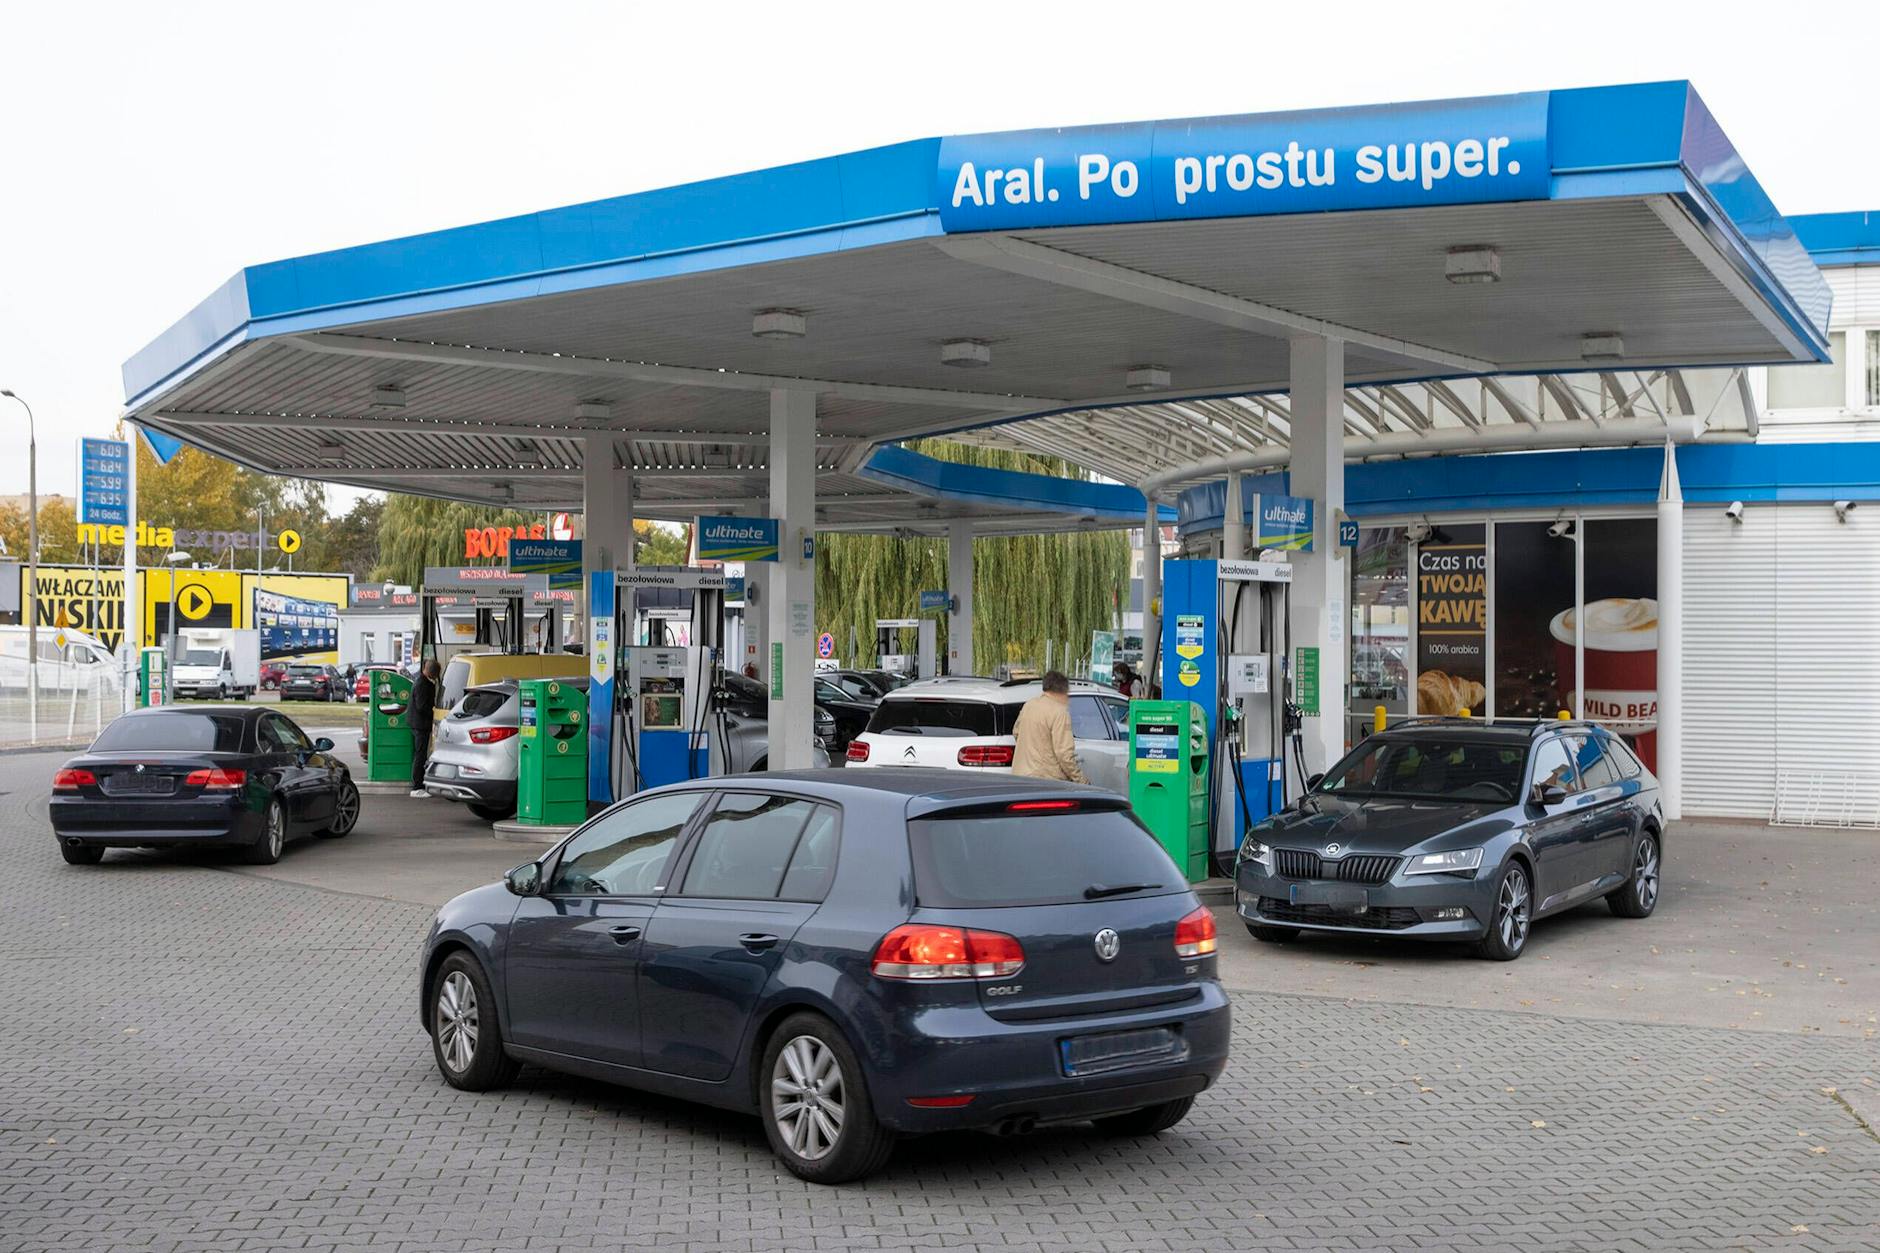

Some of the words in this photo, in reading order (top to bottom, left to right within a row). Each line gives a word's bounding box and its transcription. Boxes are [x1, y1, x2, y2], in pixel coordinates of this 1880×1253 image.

[952, 157, 1059, 207] Aral.
[1079, 153, 1140, 200] Po
[1174, 141, 1336, 205] prostu
[1355, 136, 1521, 190] super.
[89, 509, 99, 518] 24
[1264, 506, 1306, 523] ultimate
[705, 525, 764, 539] ultimate
[1341, 526, 1357, 541] 12
[515, 546, 568, 557] ultimate
[1420, 552, 1460, 571] Czas
[1220, 564, 1259, 576] bezołowiowa
[1274, 567, 1292, 578] diesel
[617, 575, 675, 584] bezołowiowa
[698, 577, 724, 585] diesel
[1420, 574, 1487, 598] TWOJĄ
[1420, 599, 1487, 629] KAWĘ
[1429, 644, 1449, 655] 100%
[1450, 645, 1479, 655] arabica
[986, 985, 1023, 997] GOLF
